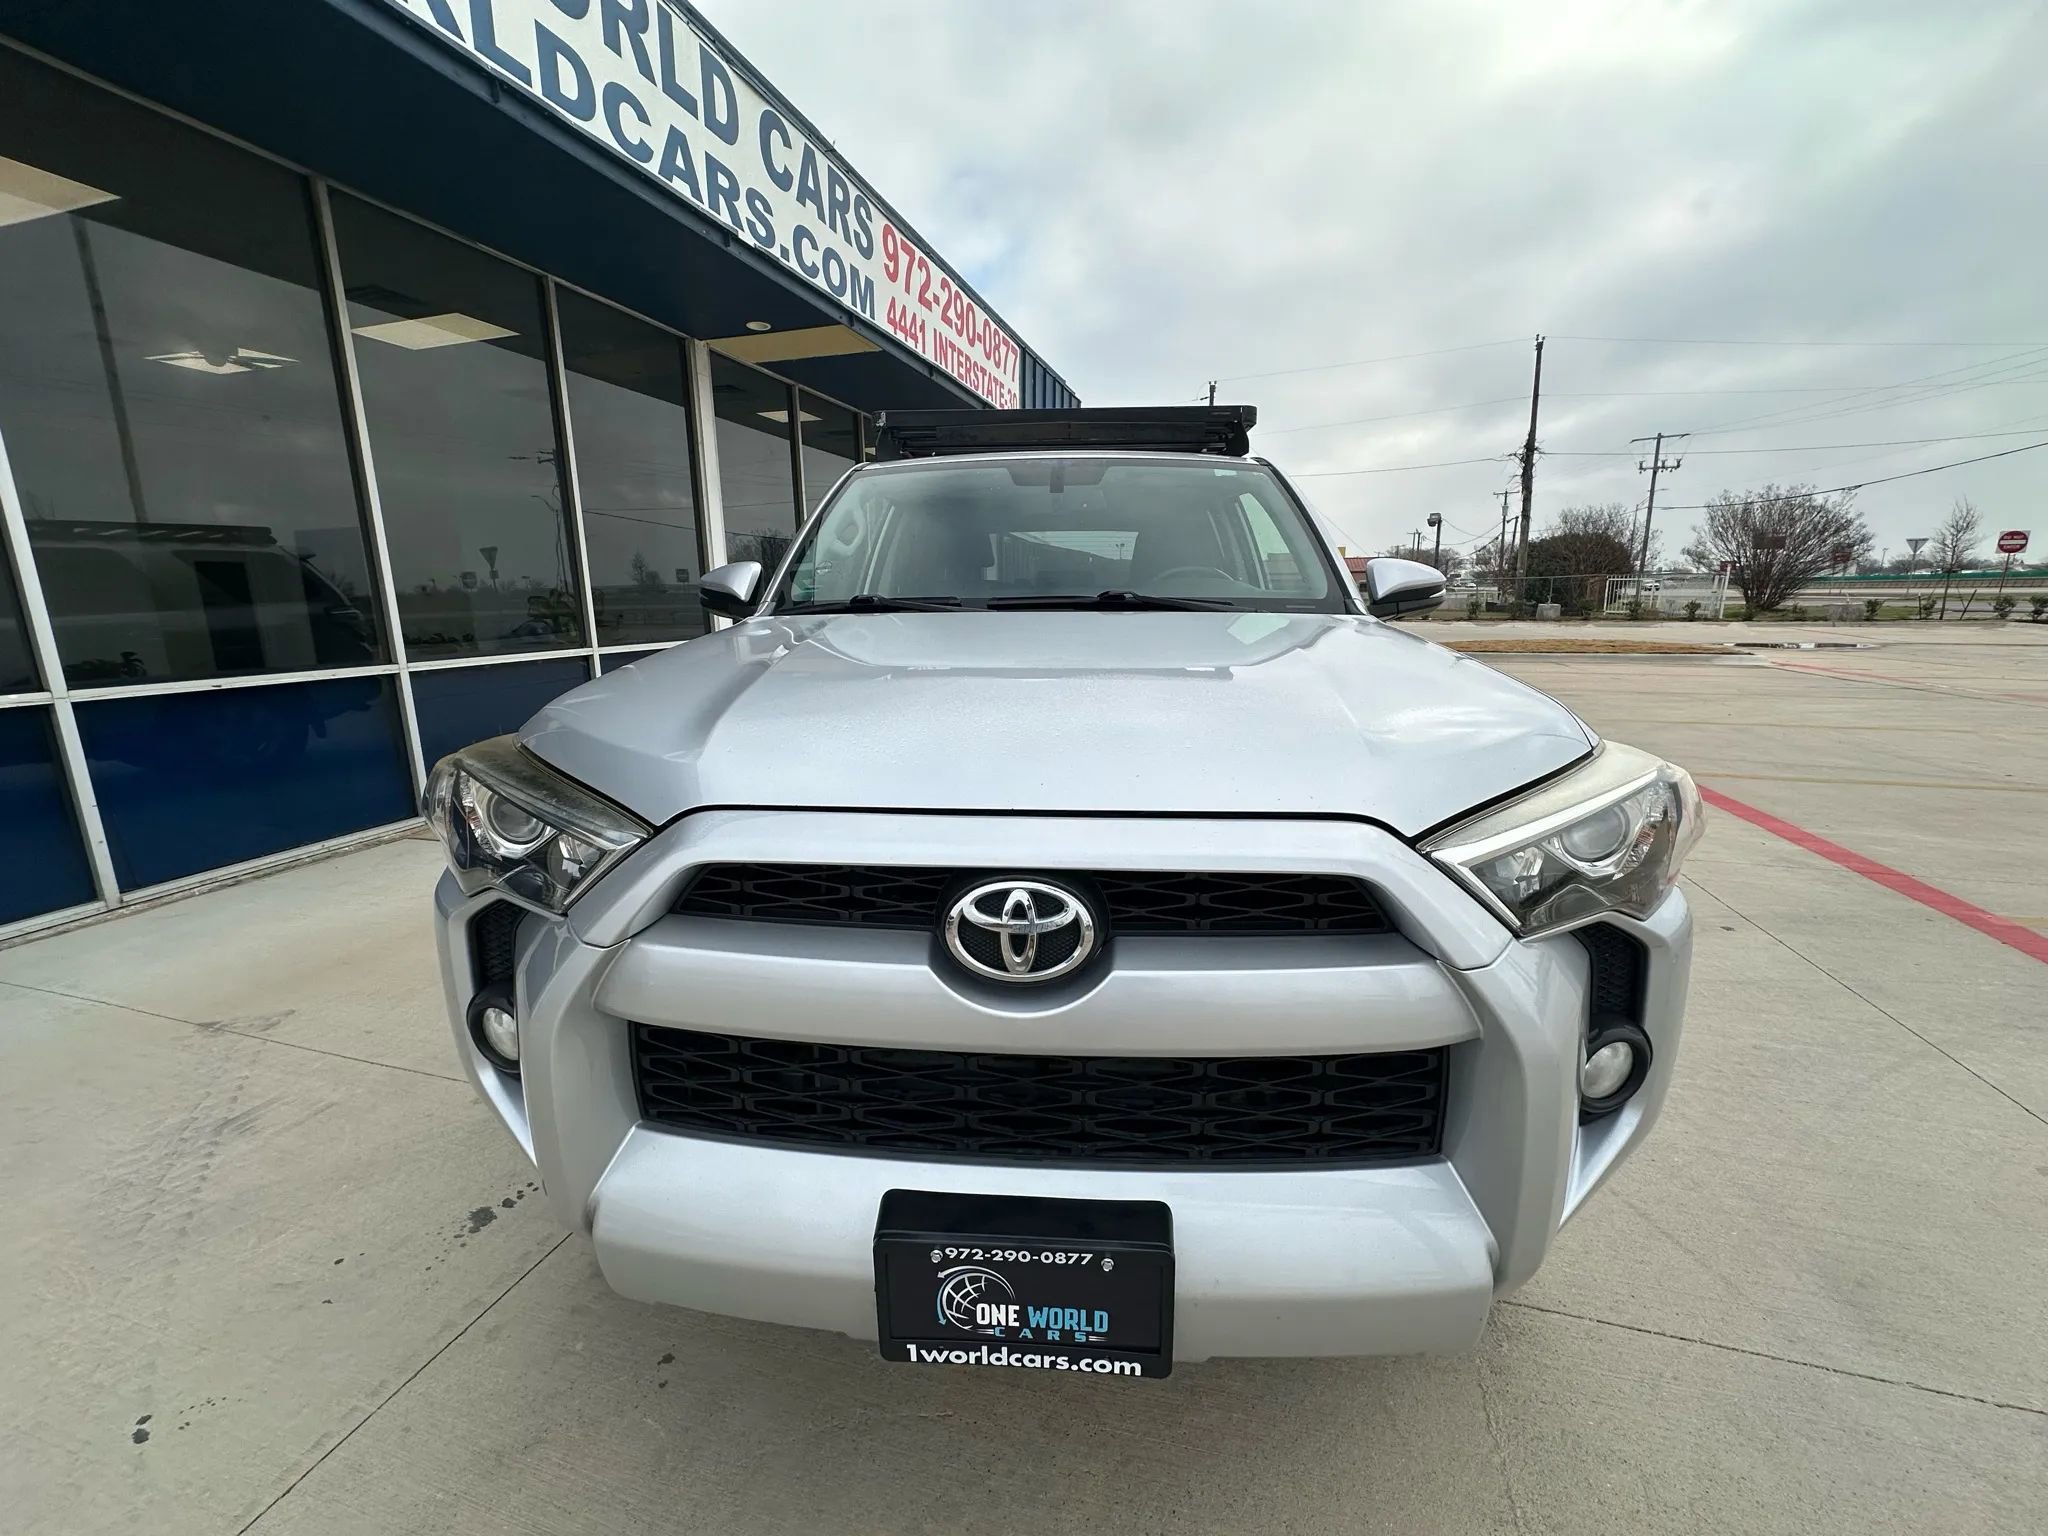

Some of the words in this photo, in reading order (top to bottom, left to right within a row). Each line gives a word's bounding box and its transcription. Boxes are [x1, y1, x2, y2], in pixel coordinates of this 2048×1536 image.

[549, 0, 739, 146] RLD
[759, 109, 874, 261] CARS
[403, 0, 876, 321] LDCARS.COM
[882, 223, 1019, 383] 972-290-0877
[886, 296, 927, 355] 4441
[945, 1247, 1093, 1265] 972-290-0877
[976, 1302, 1020, 1327] ONE
[1028, 1305, 1109, 1333] WORLD
[994, 1326, 1087, 1343] CARS
[906, 1344, 1142, 1376] 1worldcars.com
